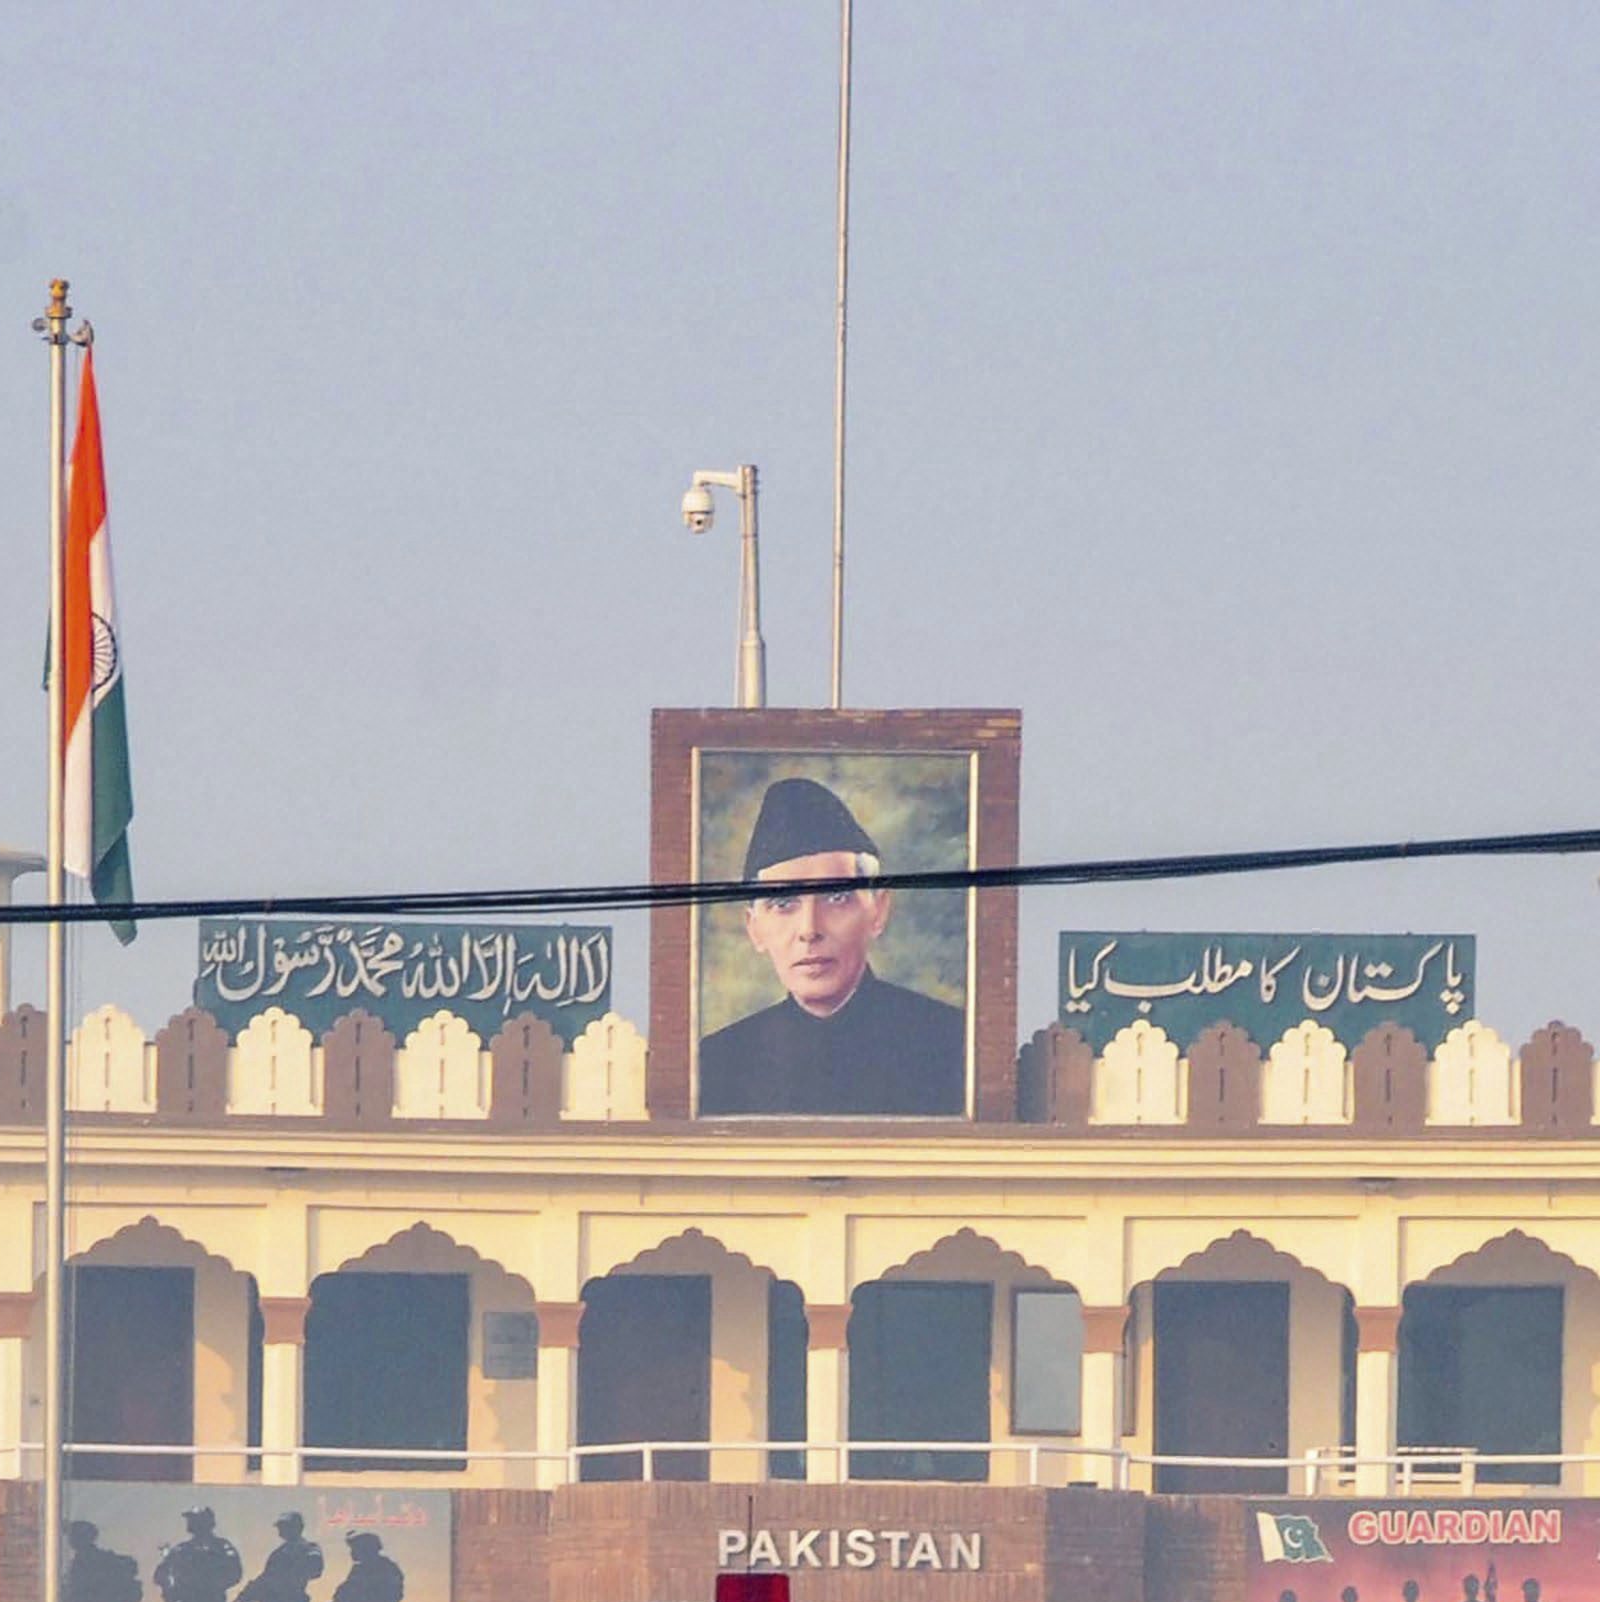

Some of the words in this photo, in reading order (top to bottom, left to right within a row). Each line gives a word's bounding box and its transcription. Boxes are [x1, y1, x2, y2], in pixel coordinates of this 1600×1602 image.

[1065, 940, 1118, 1014] کیا
[1103, 946, 1254, 1013] مطلب
[1260, 946, 1301, 1003] کا
[1303, 941, 1464, 1014] پاکستان
[717, 1528, 983, 1571] PAKISTAN
[1347, 1509, 1561, 1546] GUARDIAN
